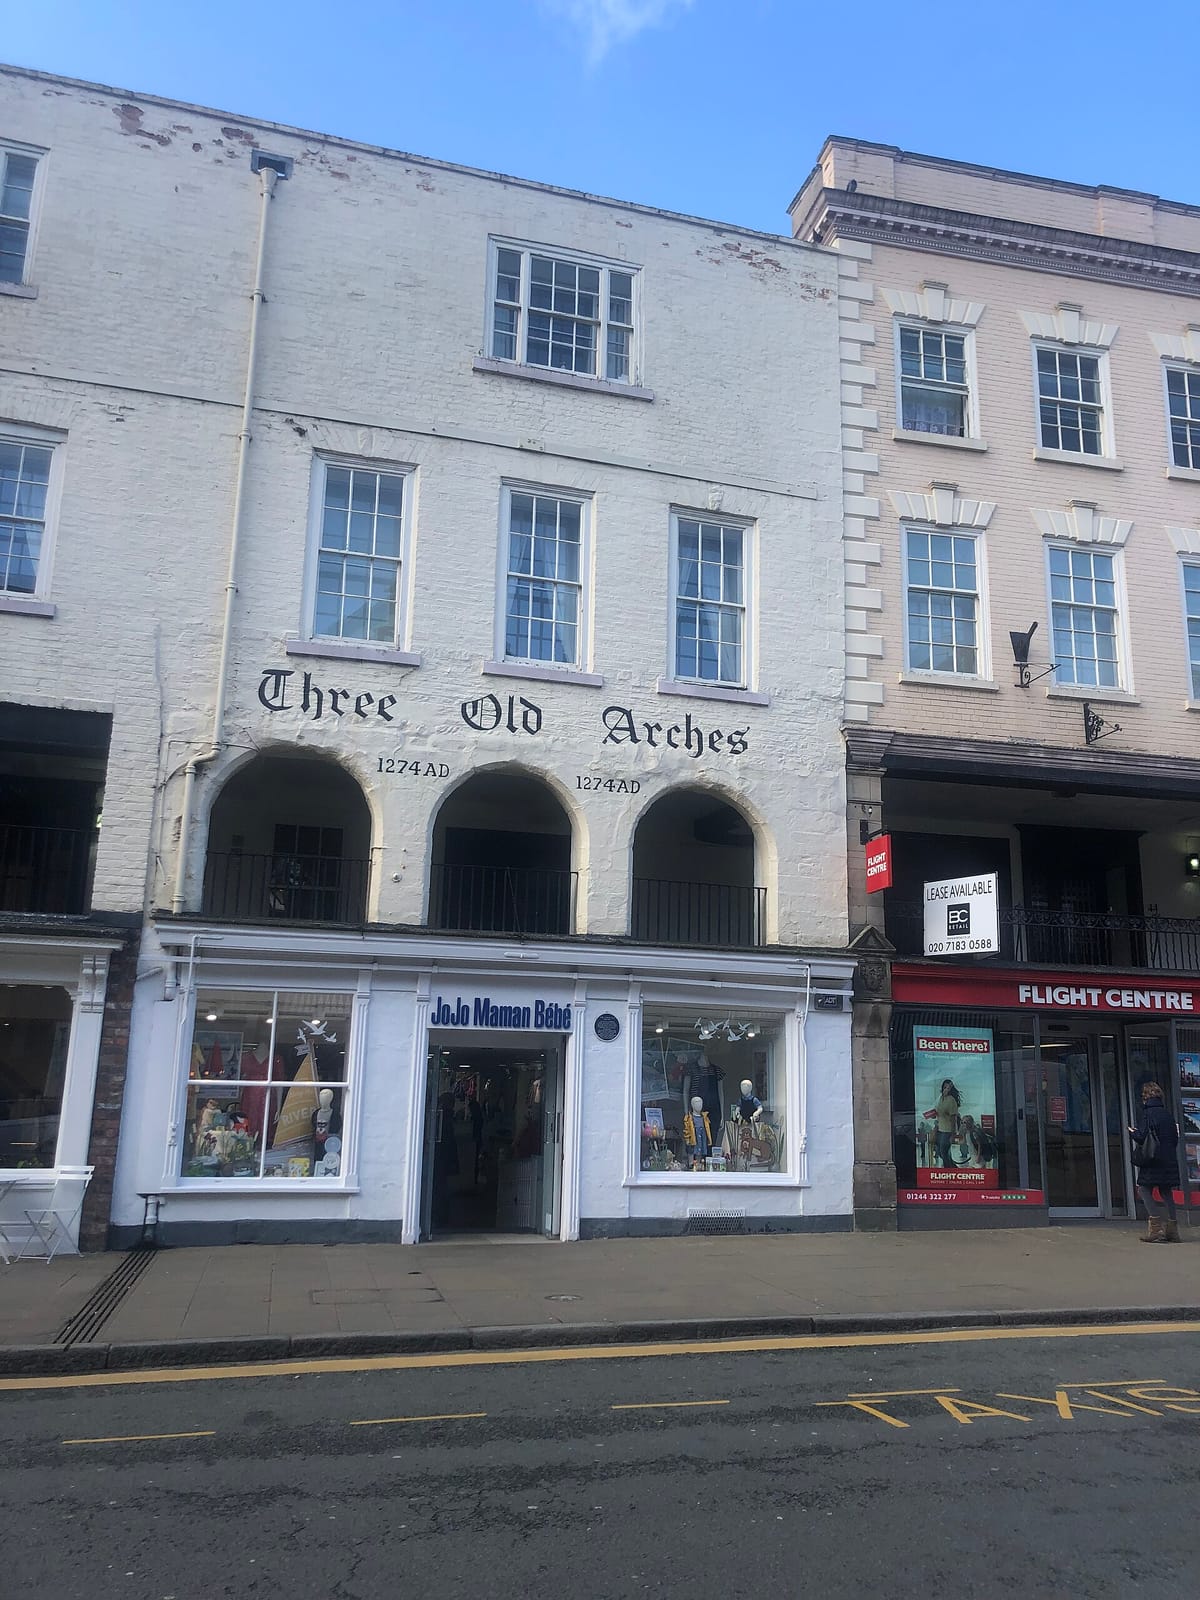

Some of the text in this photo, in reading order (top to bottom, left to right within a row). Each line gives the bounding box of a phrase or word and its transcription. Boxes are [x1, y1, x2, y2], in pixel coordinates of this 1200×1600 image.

[258, 668, 751, 759] Three Old Arches
[868, 852, 886, 867] FLIGHT
[867, 862, 887, 877] CENTRE
[926, 880, 993, 901] LEASE AVAILABLE
[949, 910, 968, 924] BC
[929, 938, 992, 952] 020 7183 0588
[1018, 984, 1194, 1010] FLIGHT CENTRE
[431, 997, 470, 1026] JoJo
[473, 998, 531, 1028] Maman
[535, 1000, 572, 1031] Bébé
[919, 1038, 988, 1052] Been there?
[930, 1172, 956, 1180] FLIGHT
